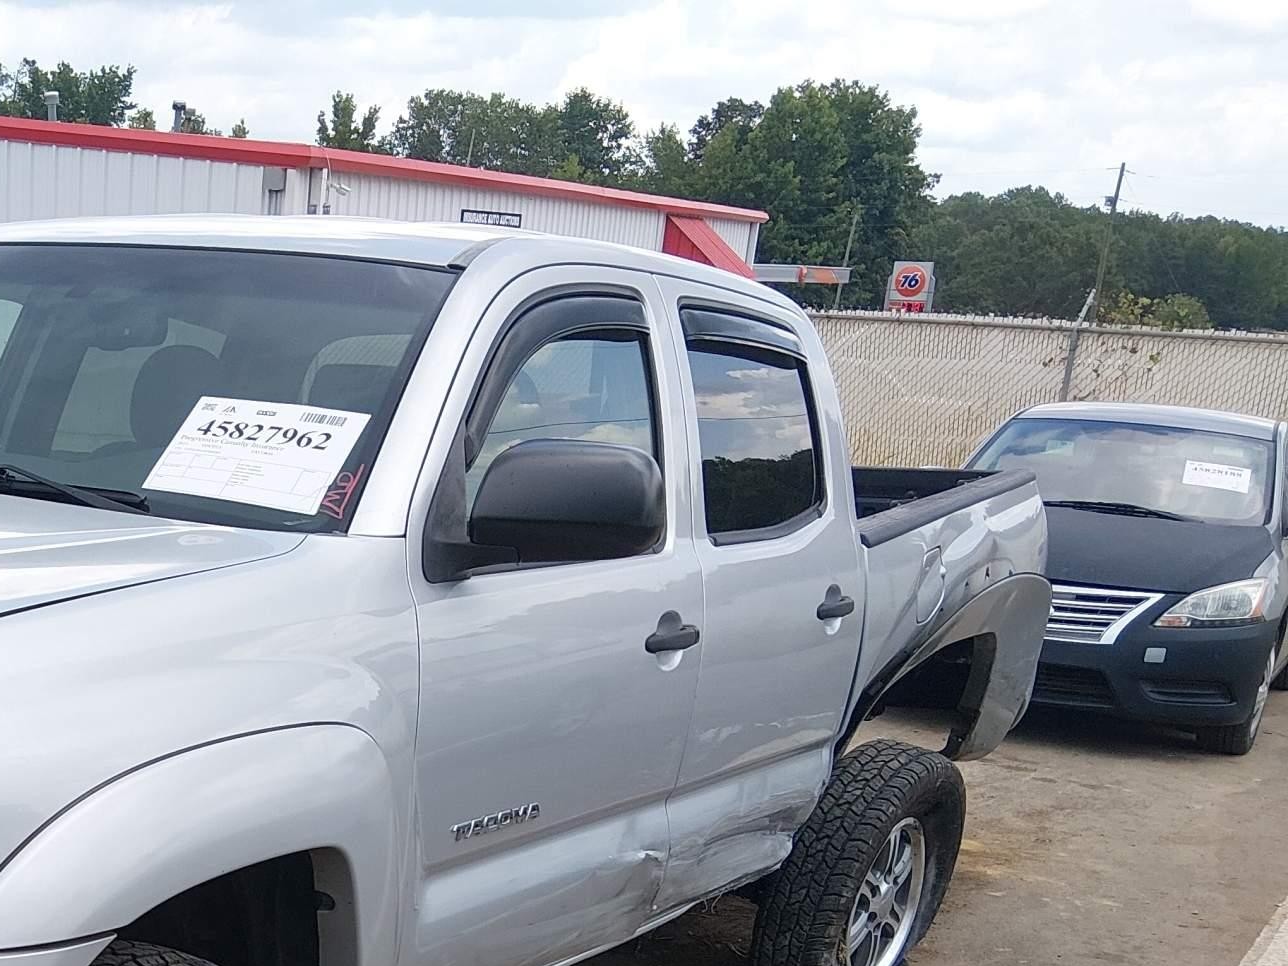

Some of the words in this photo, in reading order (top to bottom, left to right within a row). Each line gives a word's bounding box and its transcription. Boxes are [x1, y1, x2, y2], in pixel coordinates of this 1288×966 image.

[899, 272, 922, 289] 76
[197, 419, 332, 451] 45827962
[450, 802, 540, 842] TACOMA
